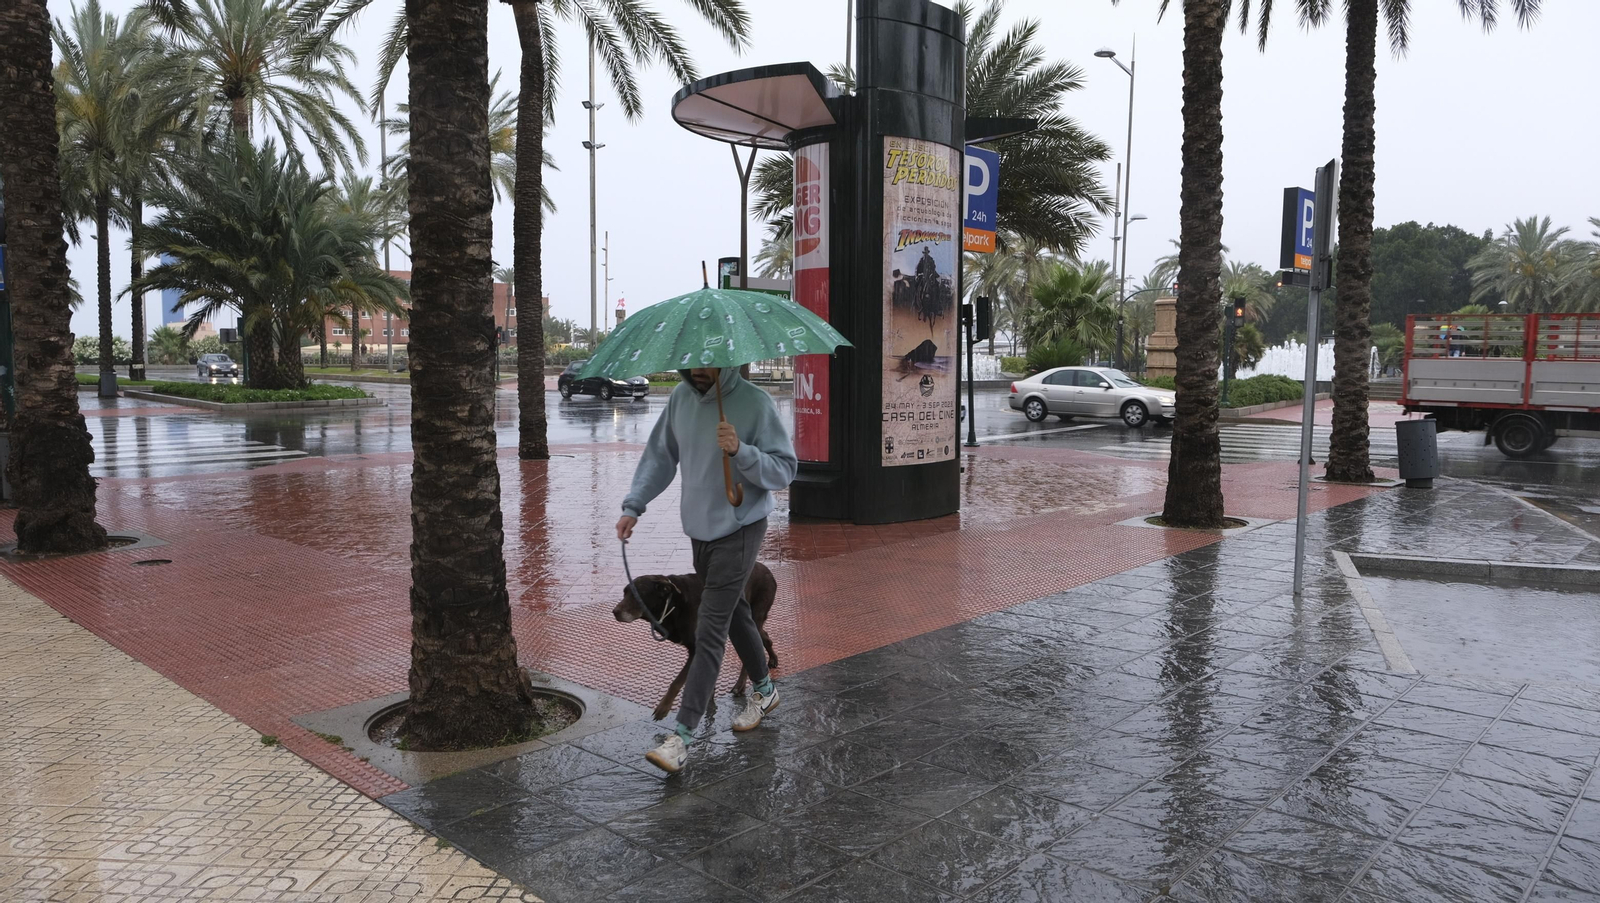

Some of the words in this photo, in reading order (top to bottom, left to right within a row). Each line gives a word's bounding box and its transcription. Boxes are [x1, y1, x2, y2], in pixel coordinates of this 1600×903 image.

[886, 149, 949, 173] TESOROS
[891, 166, 957, 191] PERDIDOS
[964, 155, 990, 219] P
[972, 209, 987, 222] 24h
[1301, 198, 1314, 247] P
[963, 231, 989, 246] elpark
[881, 411, 915, 422] CASA
[919, 411, 935, 421] DEL
[939, 409, 955, 420] CINE
